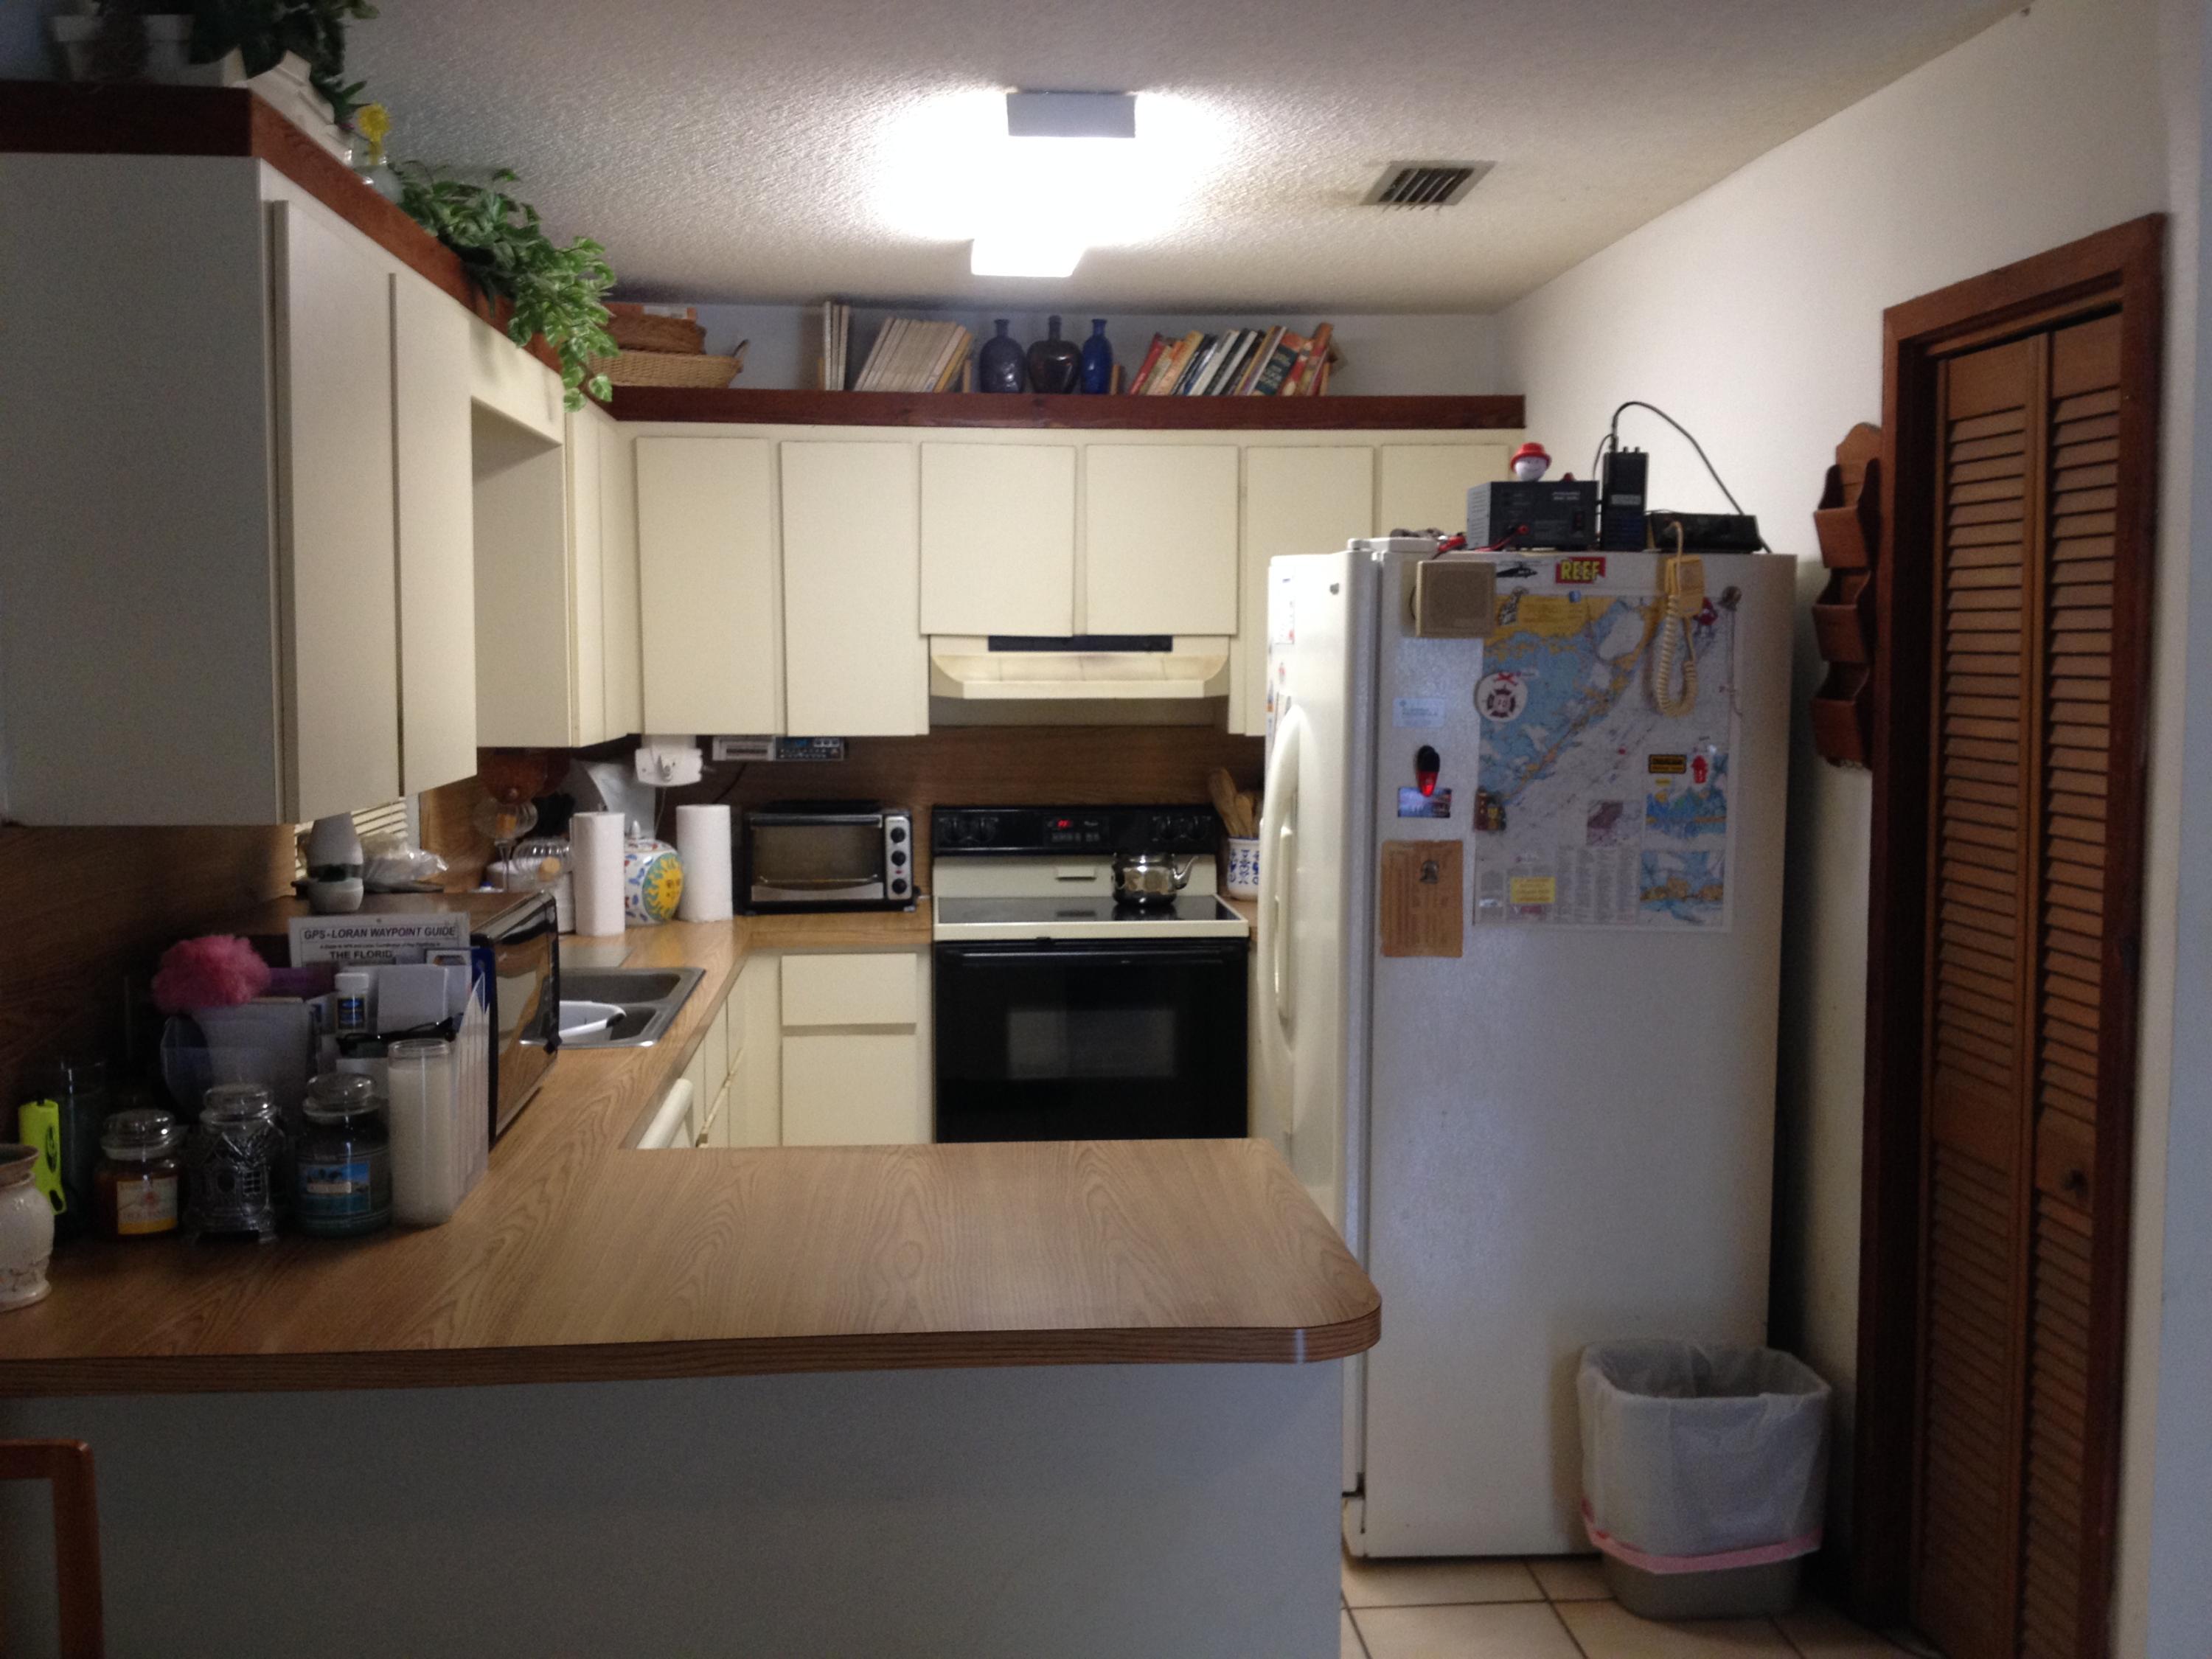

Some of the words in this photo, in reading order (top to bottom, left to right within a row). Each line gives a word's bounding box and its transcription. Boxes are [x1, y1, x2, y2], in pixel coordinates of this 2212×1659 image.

[1561, 561, 1600, 580] REEF
[370, 927, 421, 938] WAYPOINT
[424, 925, 455, 936] GUIDE
[330, 950, 350, 959] THE
[353, 950, 393, 959] FLORID
